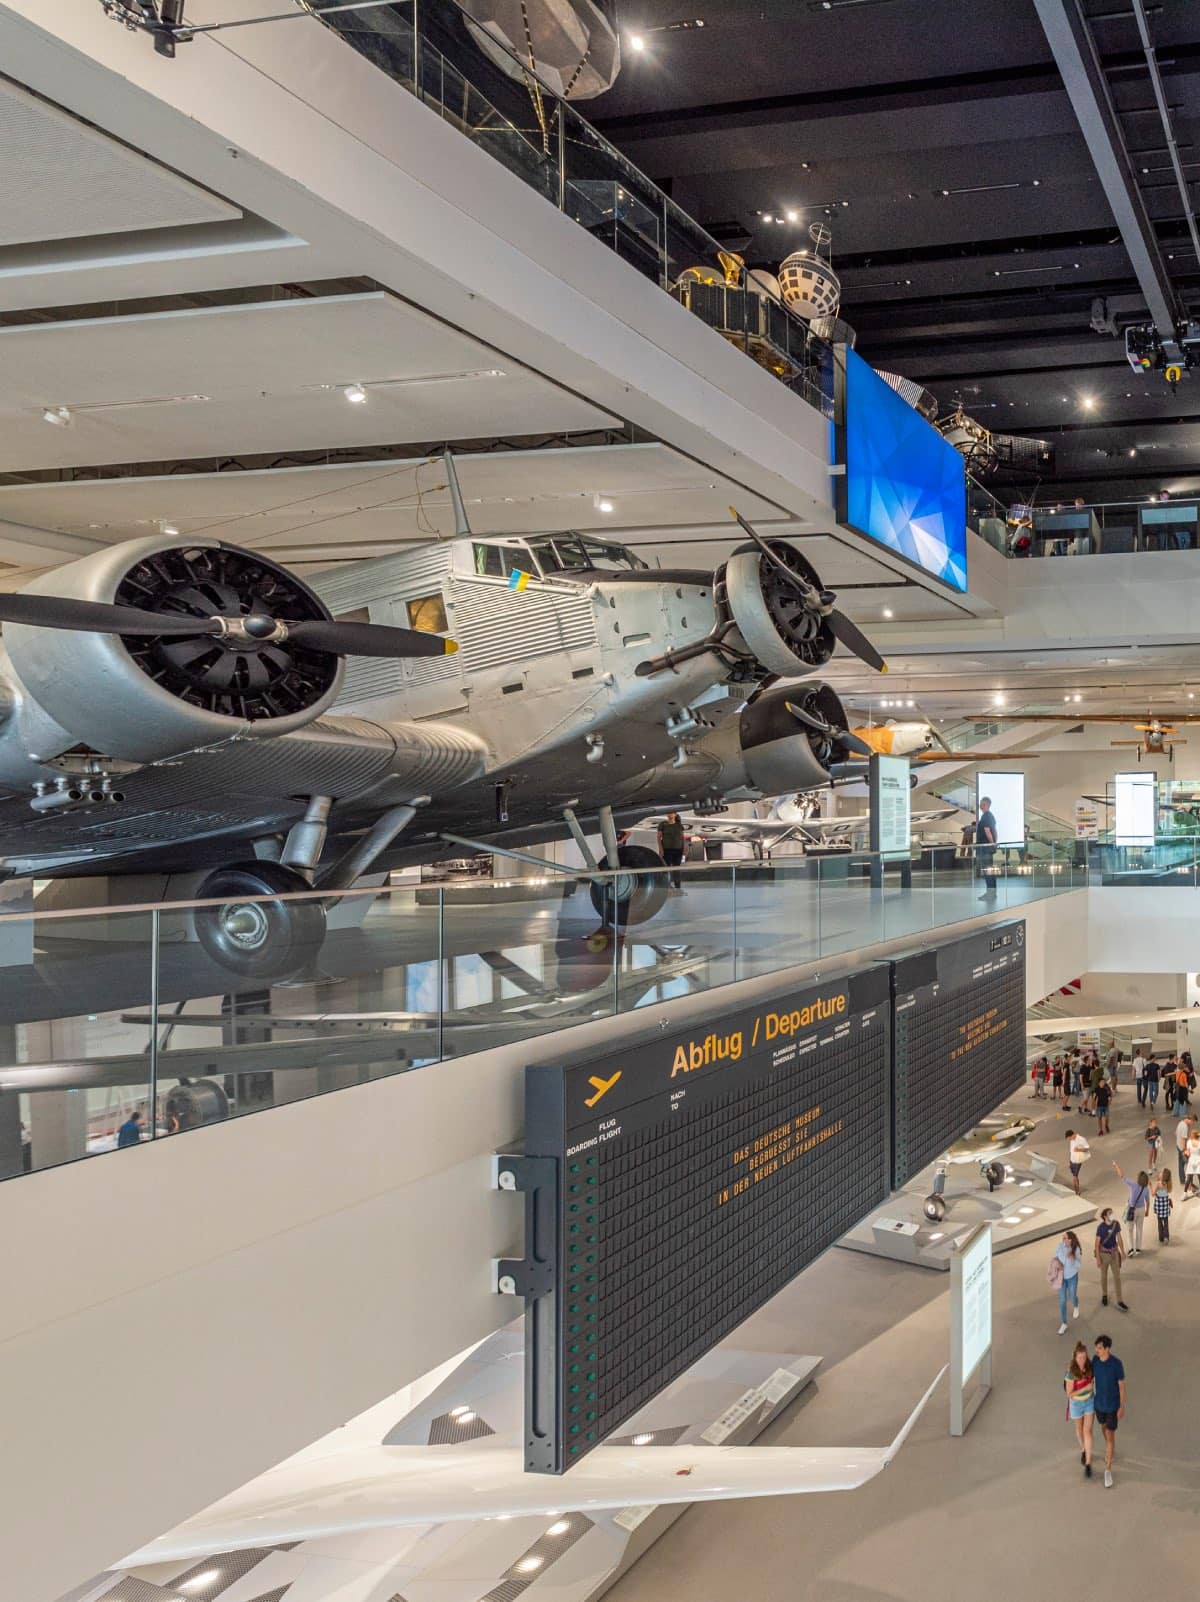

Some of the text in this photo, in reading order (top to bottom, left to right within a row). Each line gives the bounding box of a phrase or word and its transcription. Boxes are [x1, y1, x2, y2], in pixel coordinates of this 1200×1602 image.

[670, 994, 846, 1078] Abflug / Departure
[670, 1088, 686, 1101] NACH
[670, 1102, 679, 1111] TO
[599, 1118, 617, 1132] FLUG
[733, 1105, 820, 1165] DAS DEUTSCHE MUSEUM
[795, 1128, 808, 1143] SIE
[566, 1126, 623, 1157] BOARDING FLIGHT
[719, 1188, 729, 1206] IN
[733, 1176, 749, 1196] DER
